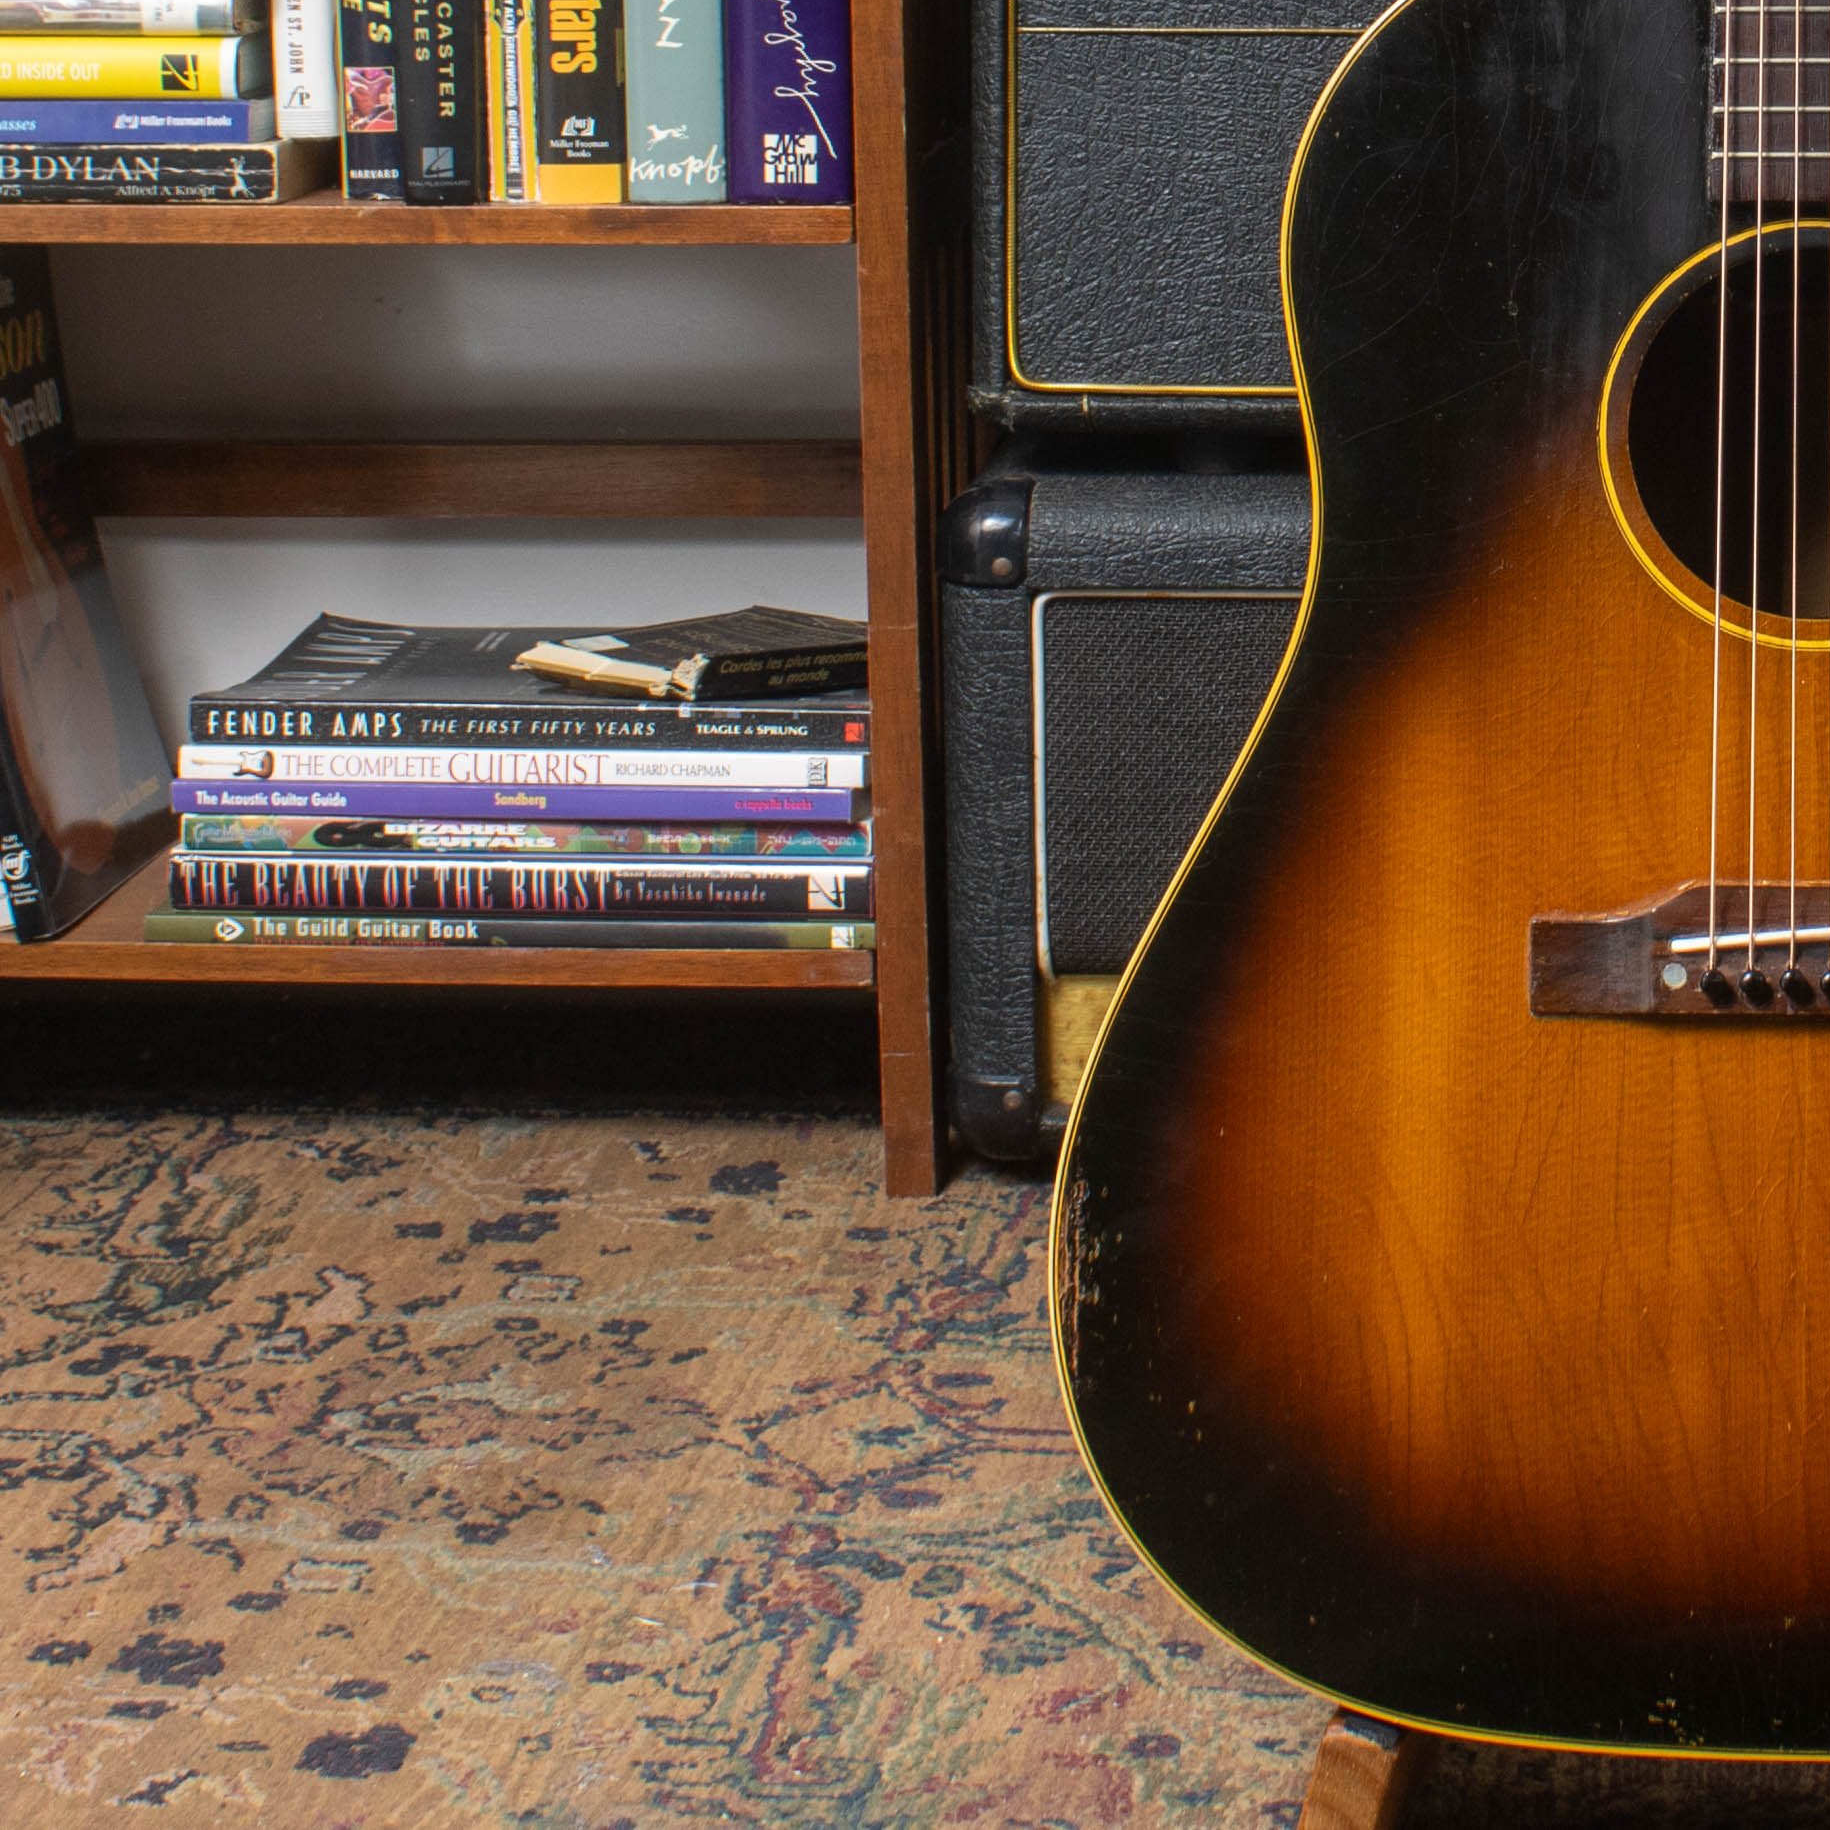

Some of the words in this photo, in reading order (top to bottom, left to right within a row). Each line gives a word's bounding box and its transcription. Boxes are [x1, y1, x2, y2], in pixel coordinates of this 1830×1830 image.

[16, 63, 66, 82] INSIDE
[69, 62, 101, 81] OUT
[31, 155, 161, 182] DYLAN
[628, 143, 725, 186] Knopf
[206, 709, 313, 737] FENDER
[331, 711, 404, 738] AMPS
[420, 719, 459, 735] THE
[464, 719, 523, 735] FIRST
[530, 720, 587, 736] FIFTY
[593, 721, 657, 737] YEARS
[281, 753, 325, 778] THE
[328, 754, 442, 779] COMPLETE
[446, 751, 611, 785] GUITARIST
[614, 762, 668, 777] RICHARD
[669, 763, 732, 778] CHAPMAN
[195, 790, 219, 807] The
[220, 790, 269, 807] Acoustic
[270, 791, 309, 808] Guitar
[311, 792, 348, 808] Guide
[492, 792, 547, 811] Sandberg
[415, 835, 558, 849] GUITARS
[179, 860, 240, 907] THE
[253, 860, 370, 909] BEAUTY
[382, 862, 420, 910] OF
[433, 864, 496, 910] THE
[511, 866, 612, 913] BURST
[252, 916, 288, 937] The
[295, 917, 350, 939] Guild
[356, 919, 421, 939] Guitar
[428, 919, 480, 941] Book
